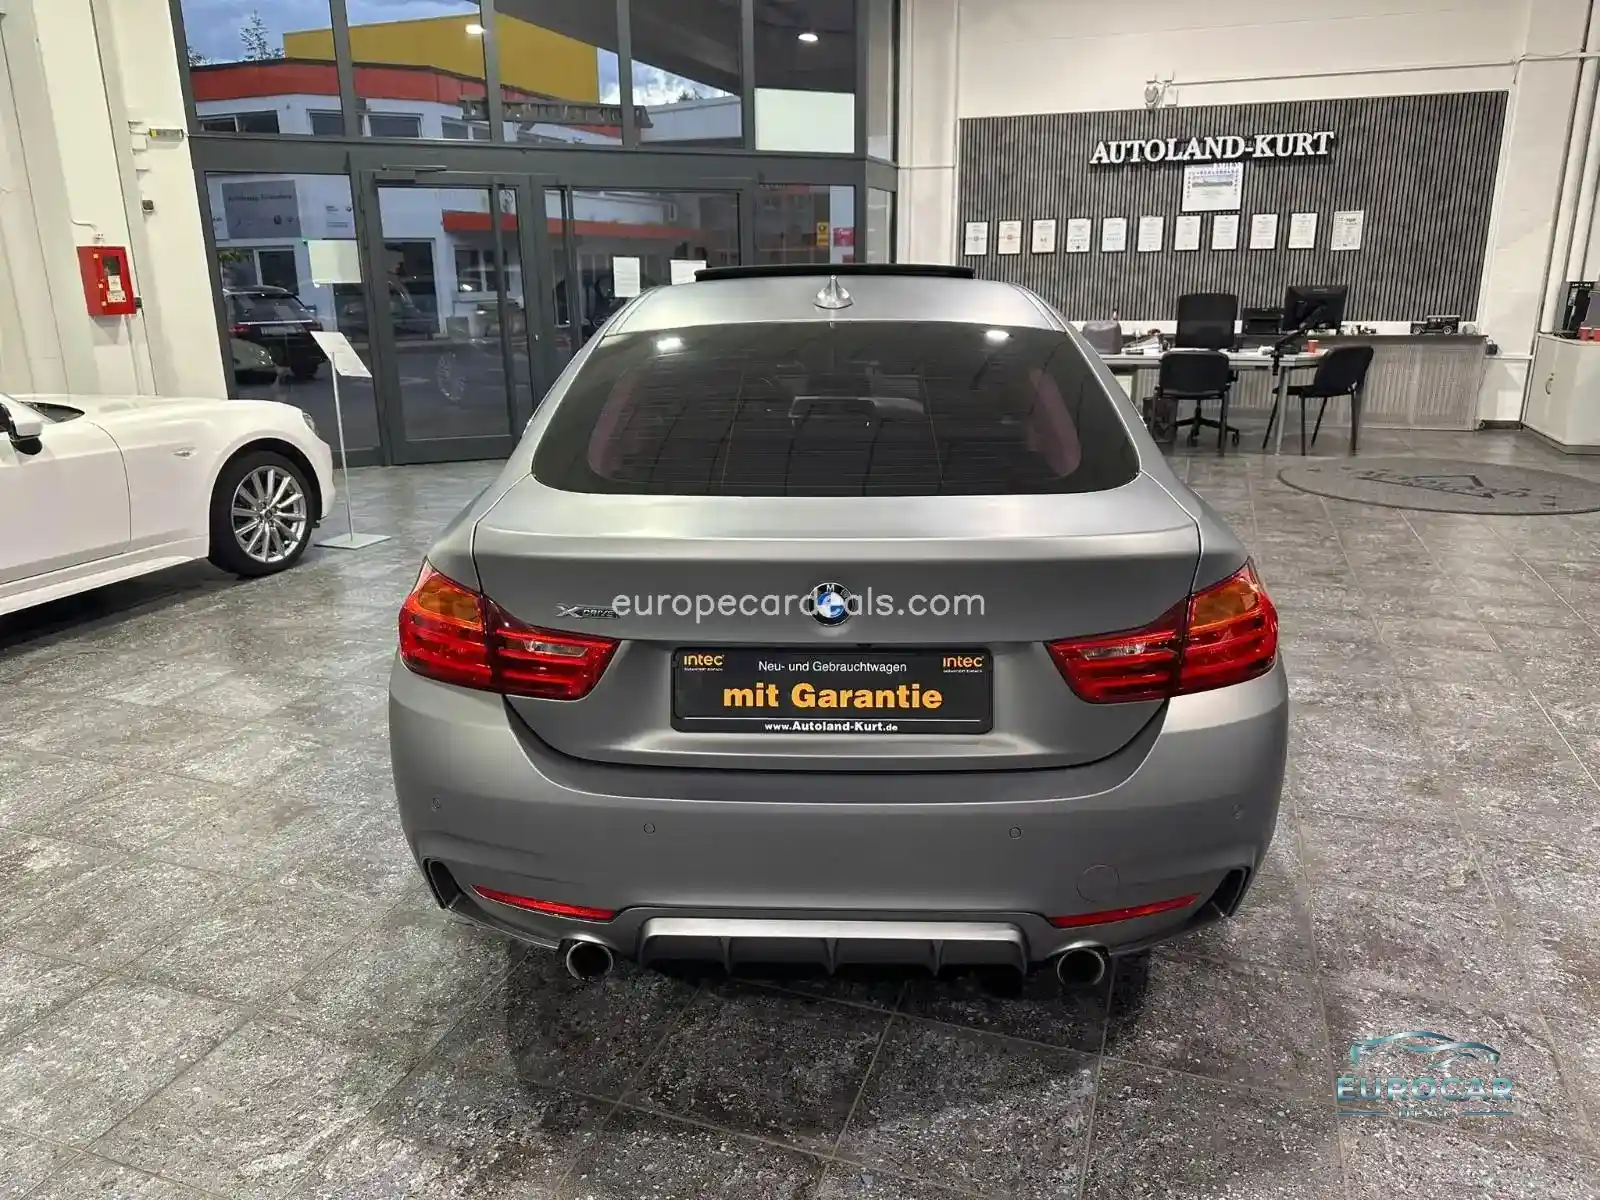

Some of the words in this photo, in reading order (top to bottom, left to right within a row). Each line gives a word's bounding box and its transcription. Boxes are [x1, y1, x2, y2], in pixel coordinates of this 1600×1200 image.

[1089, 131, 1335, 165] AUTOLAND-KURT
[683, 653, 724, 667] intec
[942, 655, 983, 668] intec
[758, 660, 785, 672] Neu-
[788, 660, 810, 672] und
[812, 660, 907, 675] Gebrauchtwagen
[723, 682, 779, 708] mit
[791, 682, 943, 709] Garantie
[764, 720, 898, 732] www.Autoland-Kurt.de
